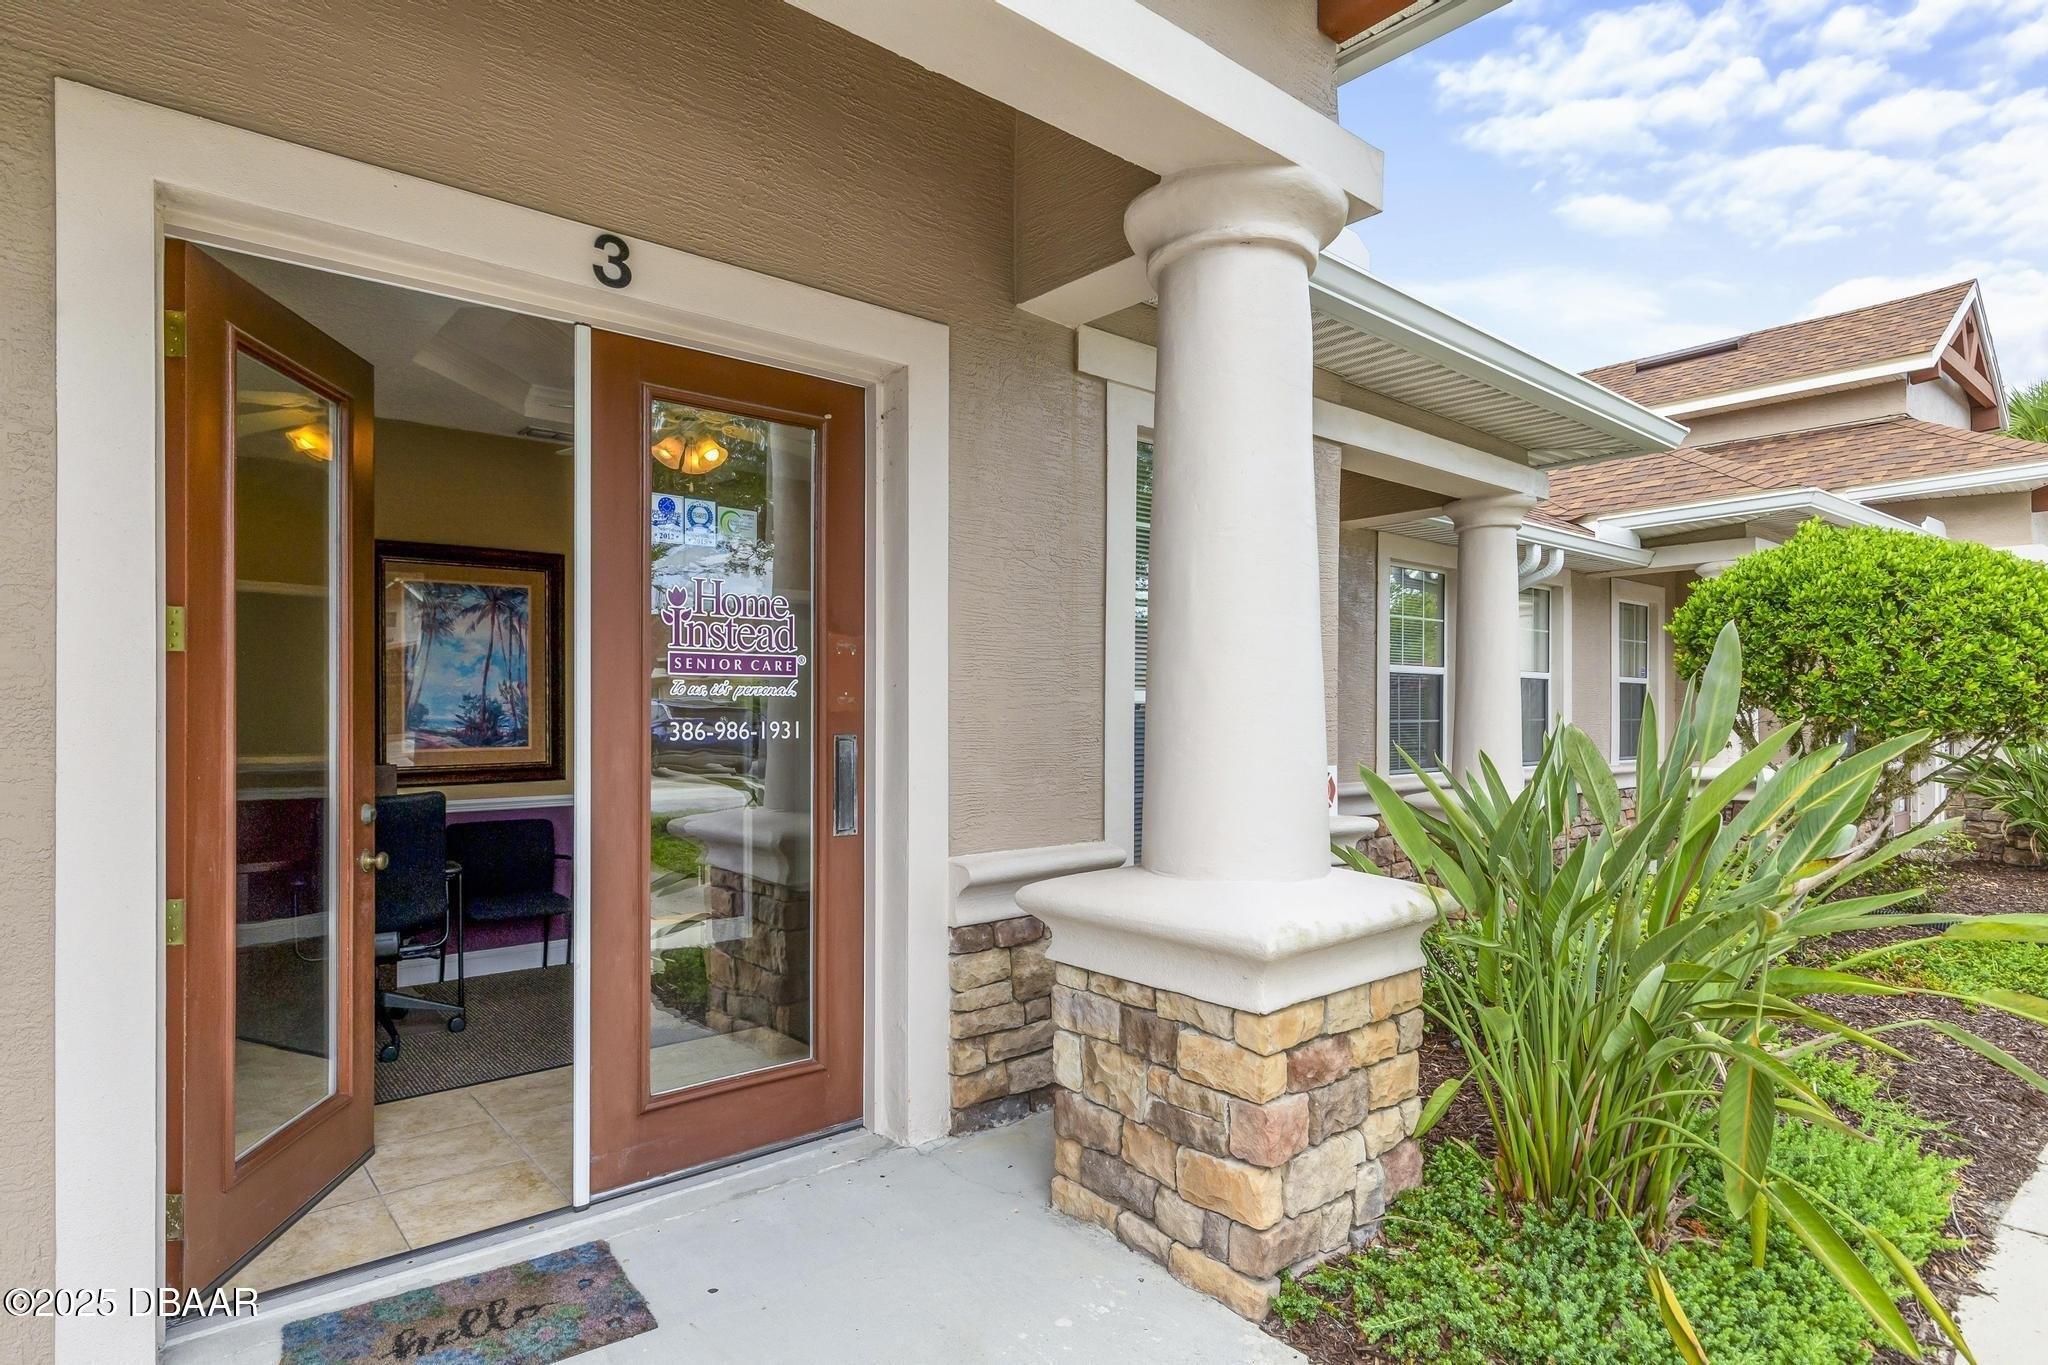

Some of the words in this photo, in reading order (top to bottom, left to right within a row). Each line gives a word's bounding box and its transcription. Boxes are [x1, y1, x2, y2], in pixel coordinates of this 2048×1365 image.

[592, 233, 632, 289] 3
[691, 577, 790, 621] Home
[667, 605, 798, 653] Instead
[674, 657, 742, 671] SENIOR
[750, 660, 793, 672] CARE
[670, 679, 687, 696] To
[687, 684, 709, 697] us,
[709, 680, 733, 696] it's
[732, 679, 799, 701] personal.
[669, 720, 800, 741] 386-986-1931
[379, 1298, 560, 1360] hello
